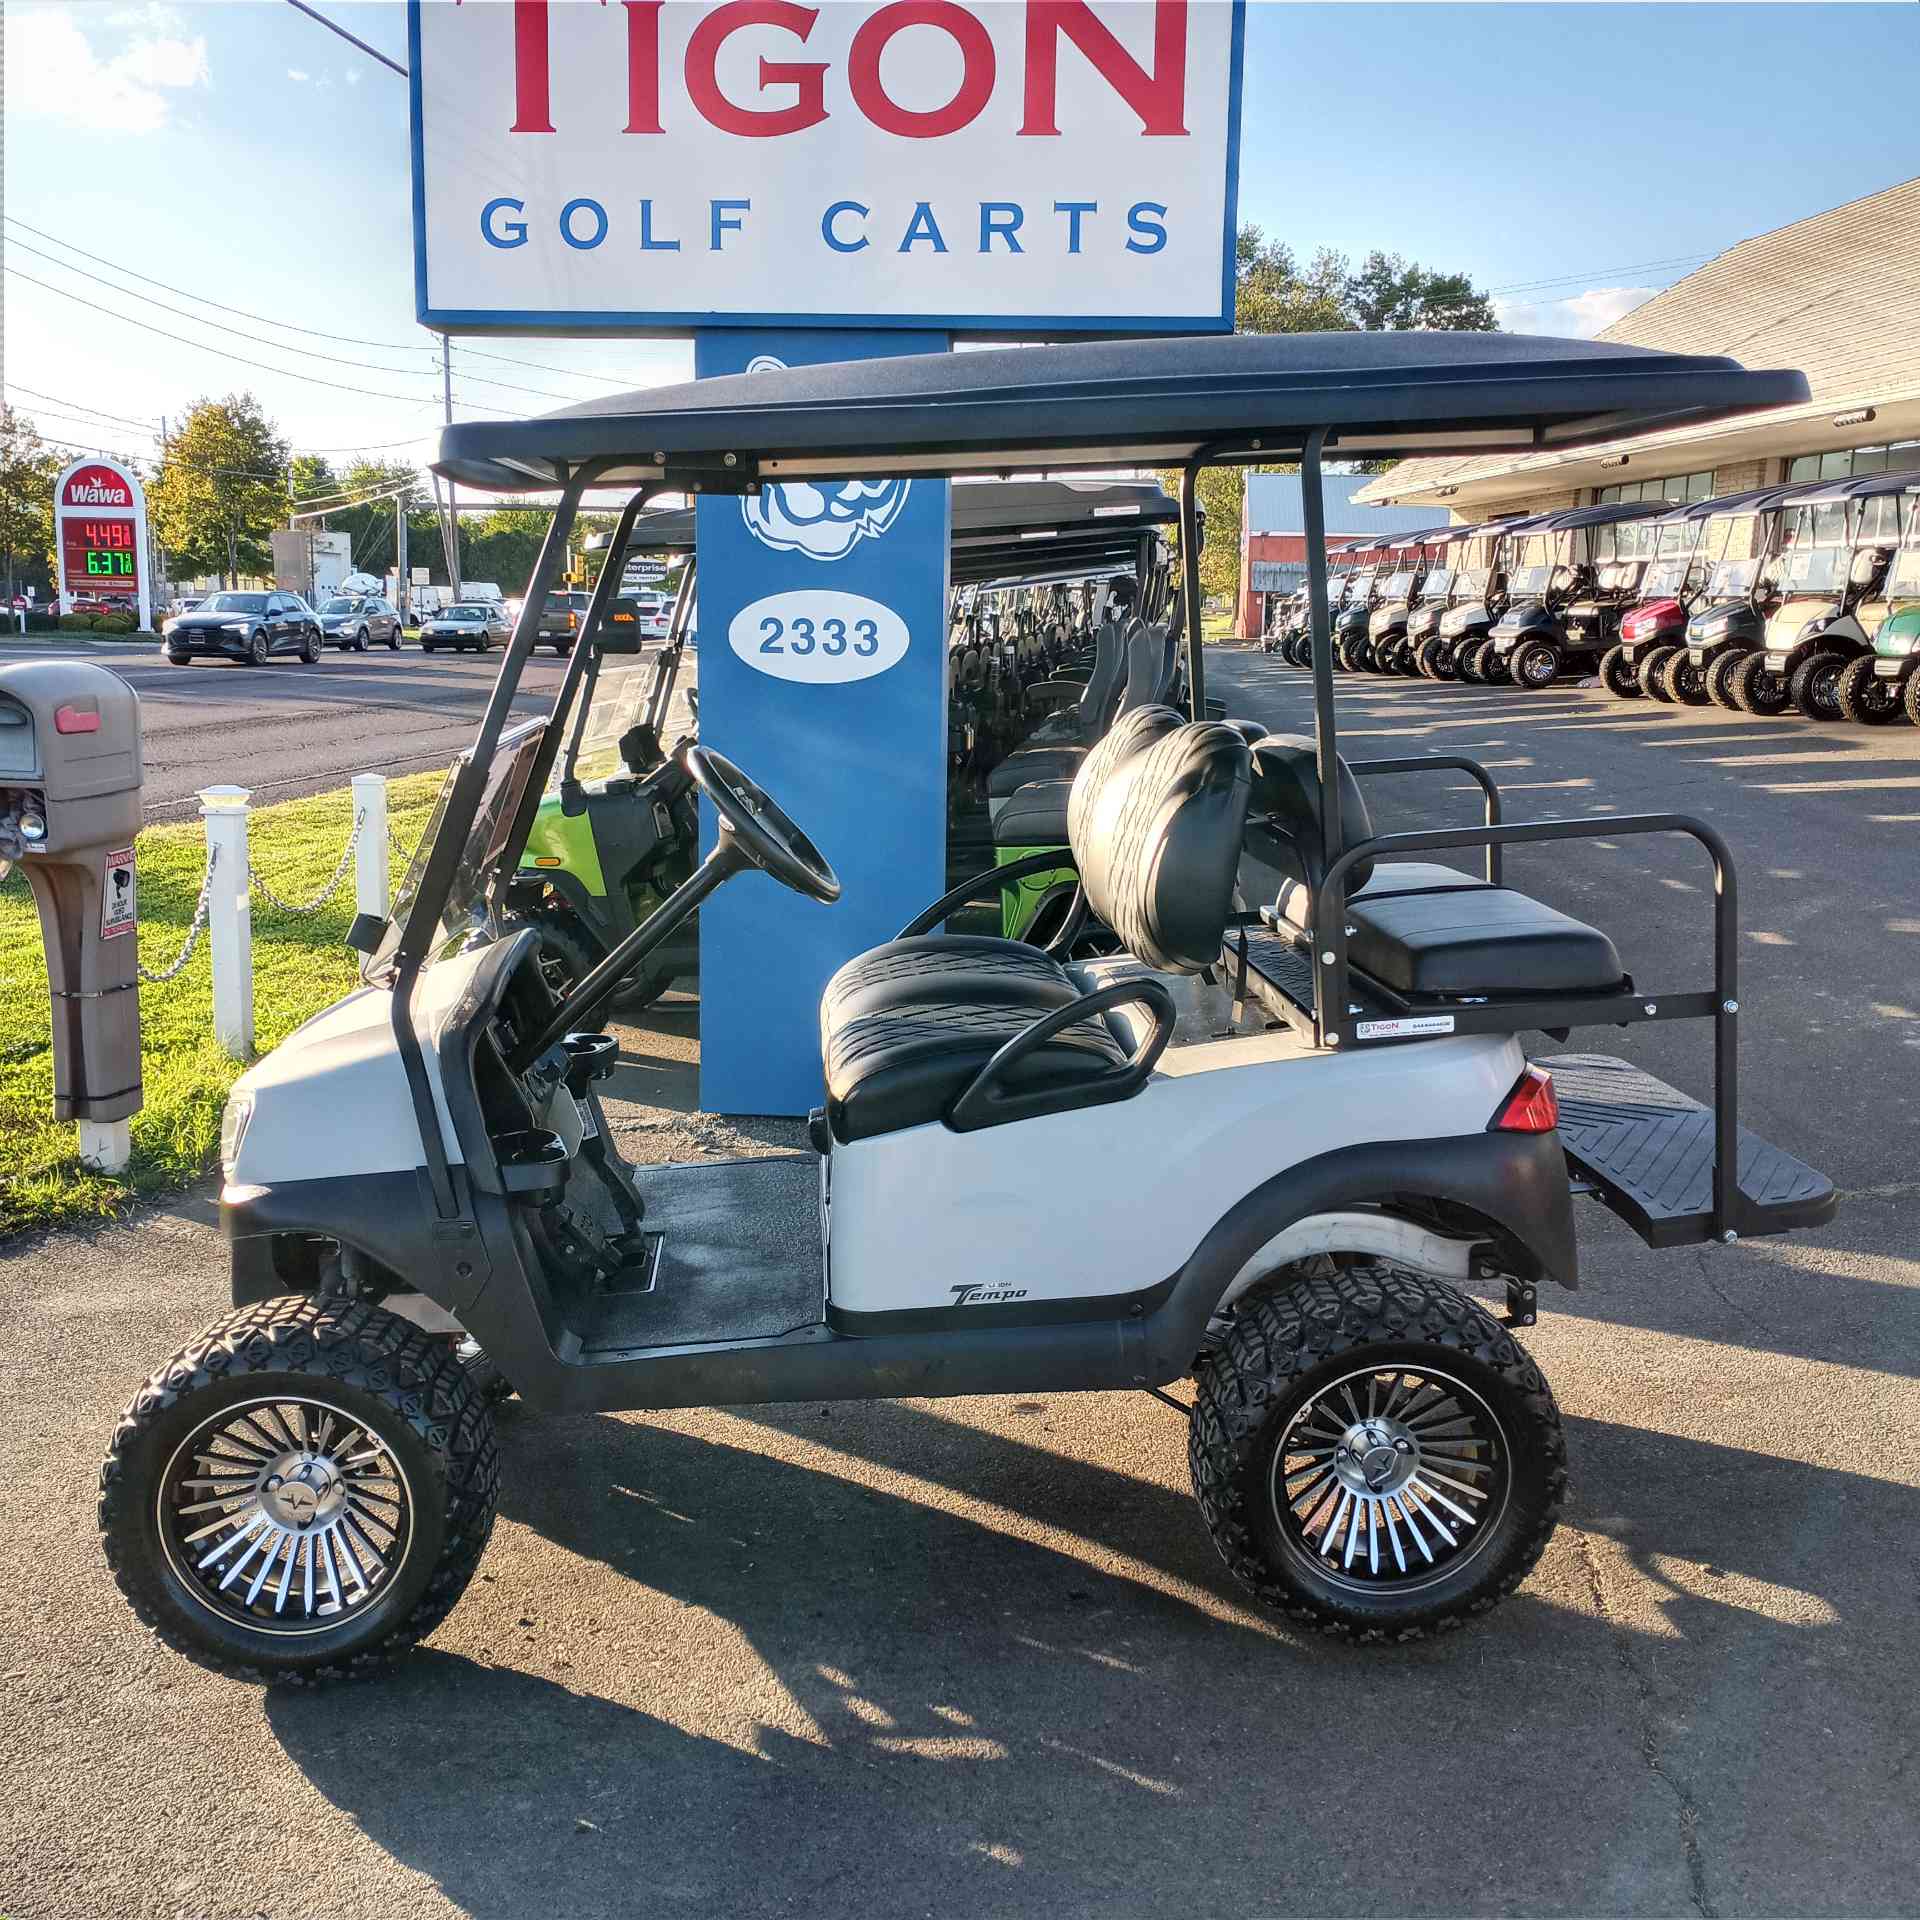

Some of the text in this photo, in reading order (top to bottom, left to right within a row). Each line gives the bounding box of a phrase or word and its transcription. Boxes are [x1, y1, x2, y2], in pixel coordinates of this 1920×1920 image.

[480, 198, 1168, 255] GOLF CARTS
[70, 484, 126, 504] Wawa
[759, 617, 880, 657] 2333
[950, 1283, 1028, 1305] Tempo
